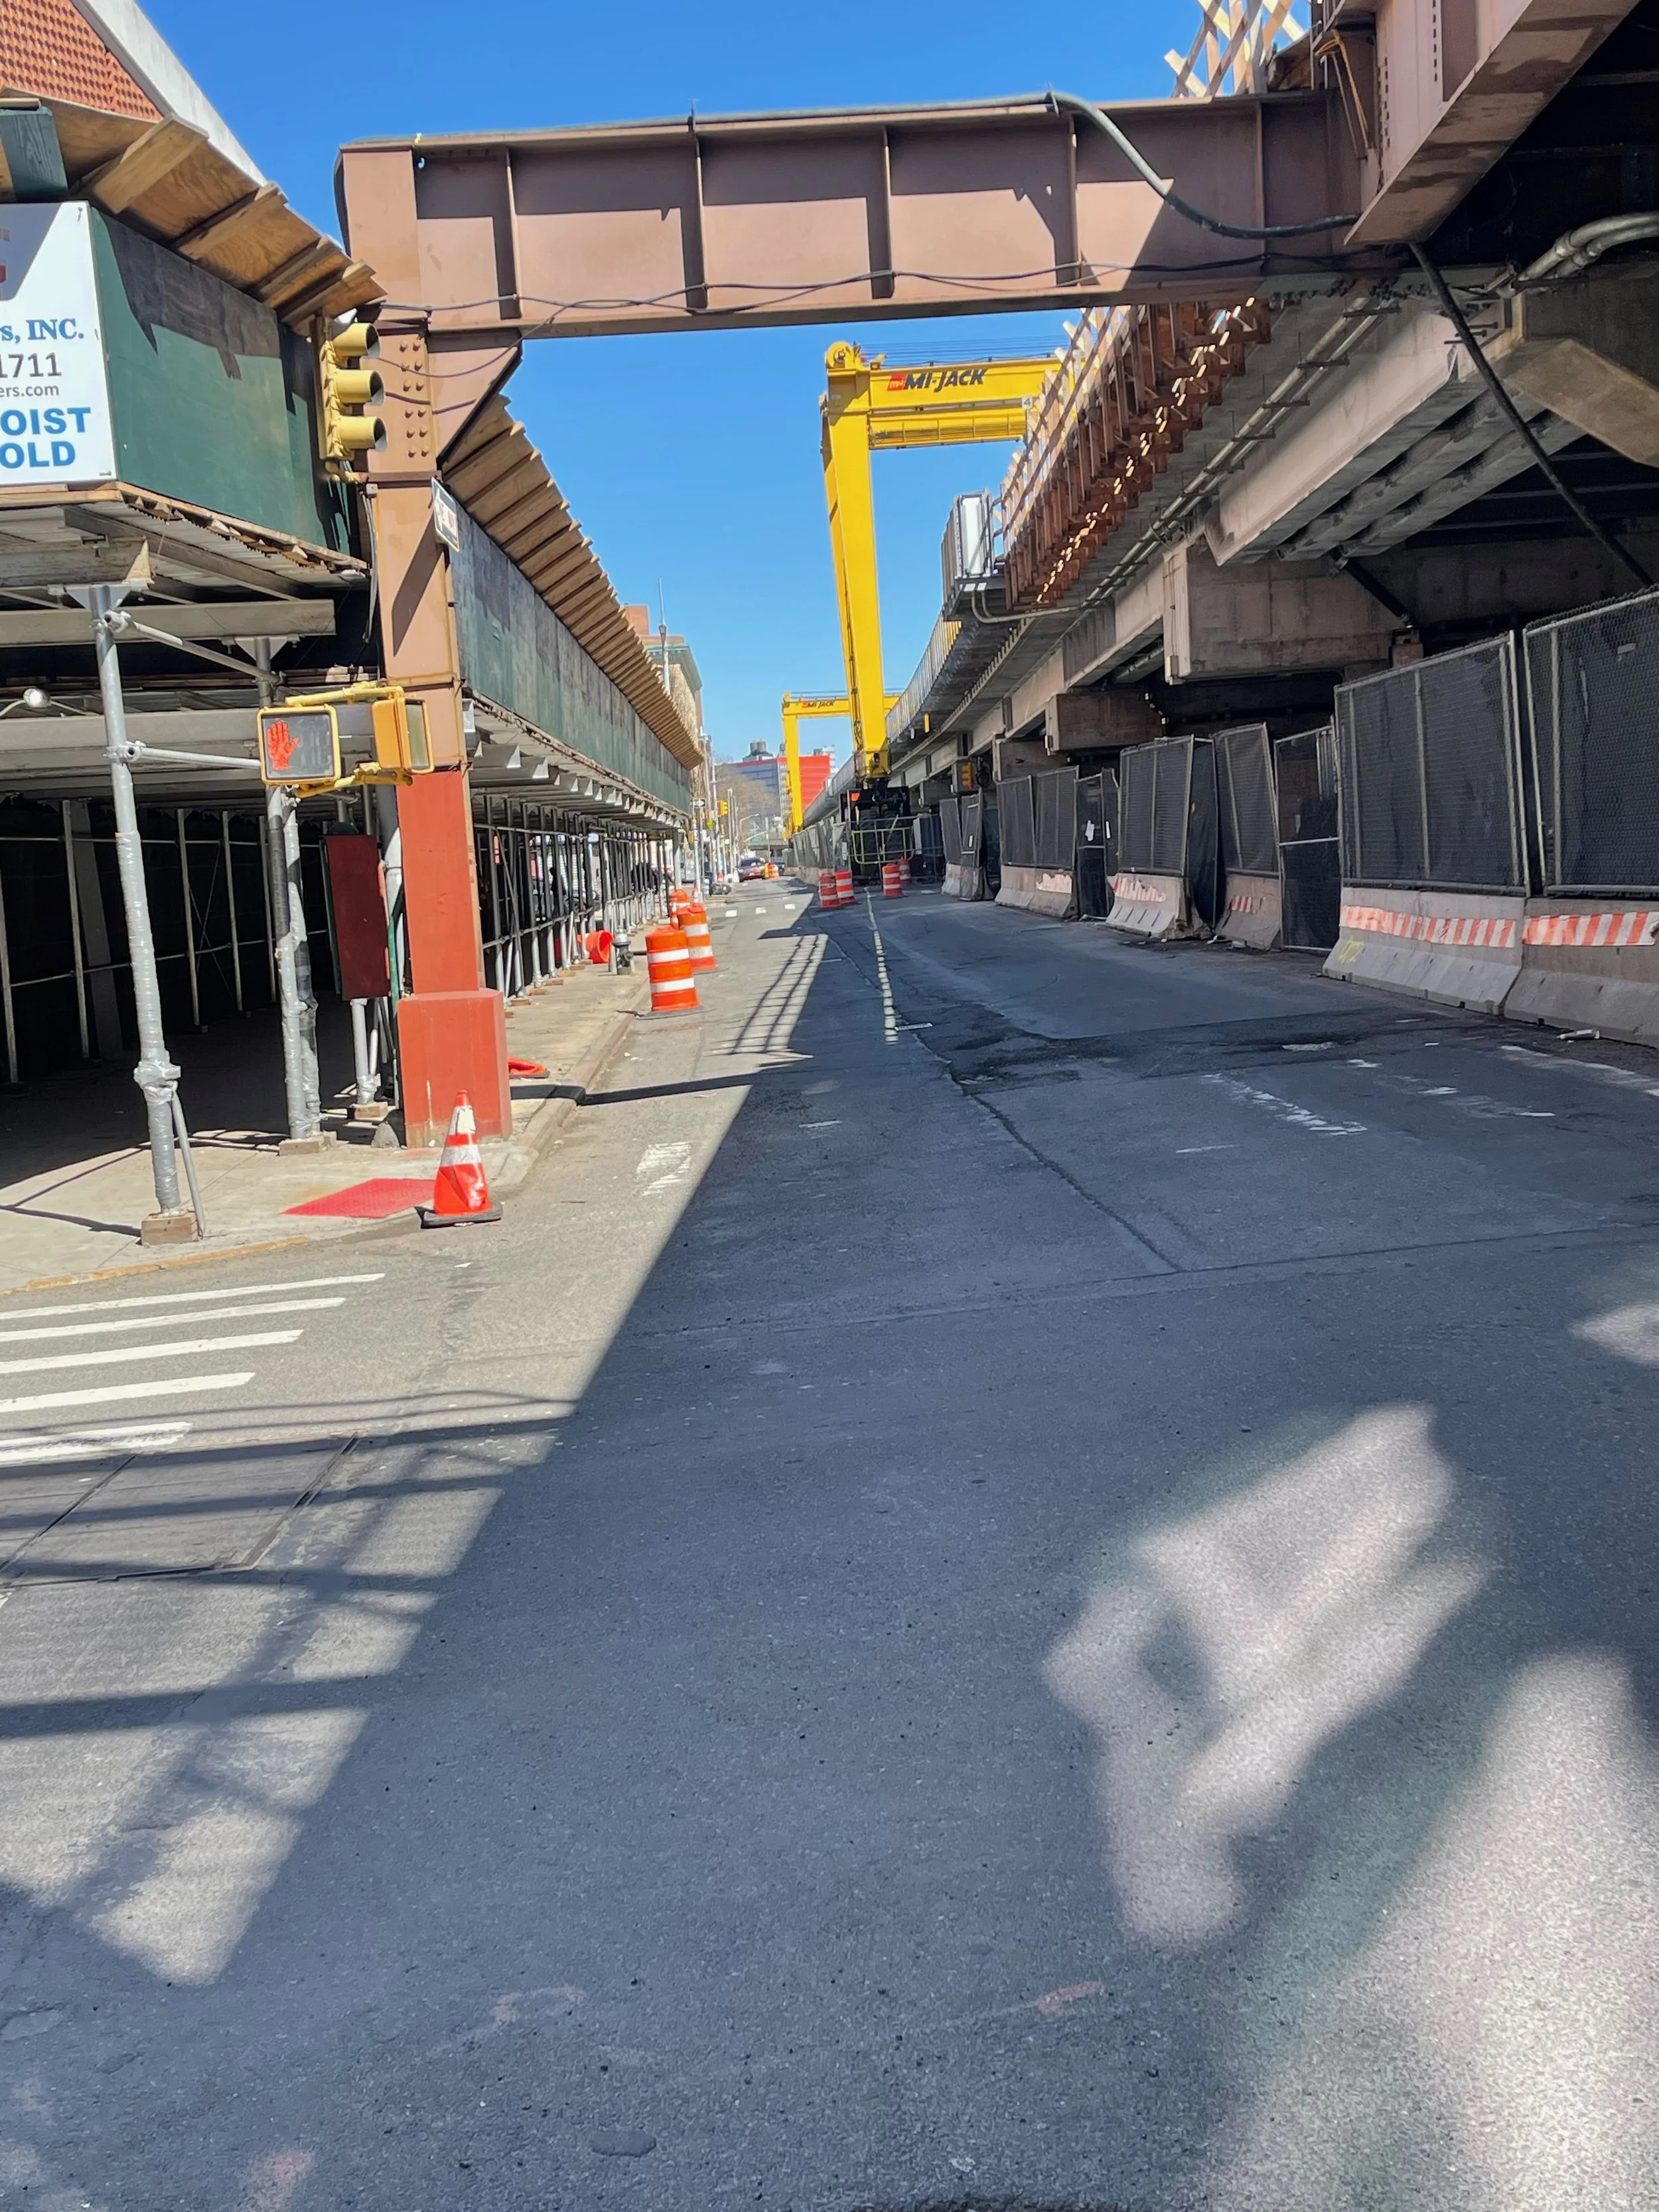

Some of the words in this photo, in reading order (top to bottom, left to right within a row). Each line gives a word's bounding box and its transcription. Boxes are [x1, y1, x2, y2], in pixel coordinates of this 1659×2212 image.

[25, 318, 84, 340] INC.
[904, 368, 987, 392] MI-JACK
[0, 407, 90, 435] OIST
[0, 441, 76, 469] OLD
